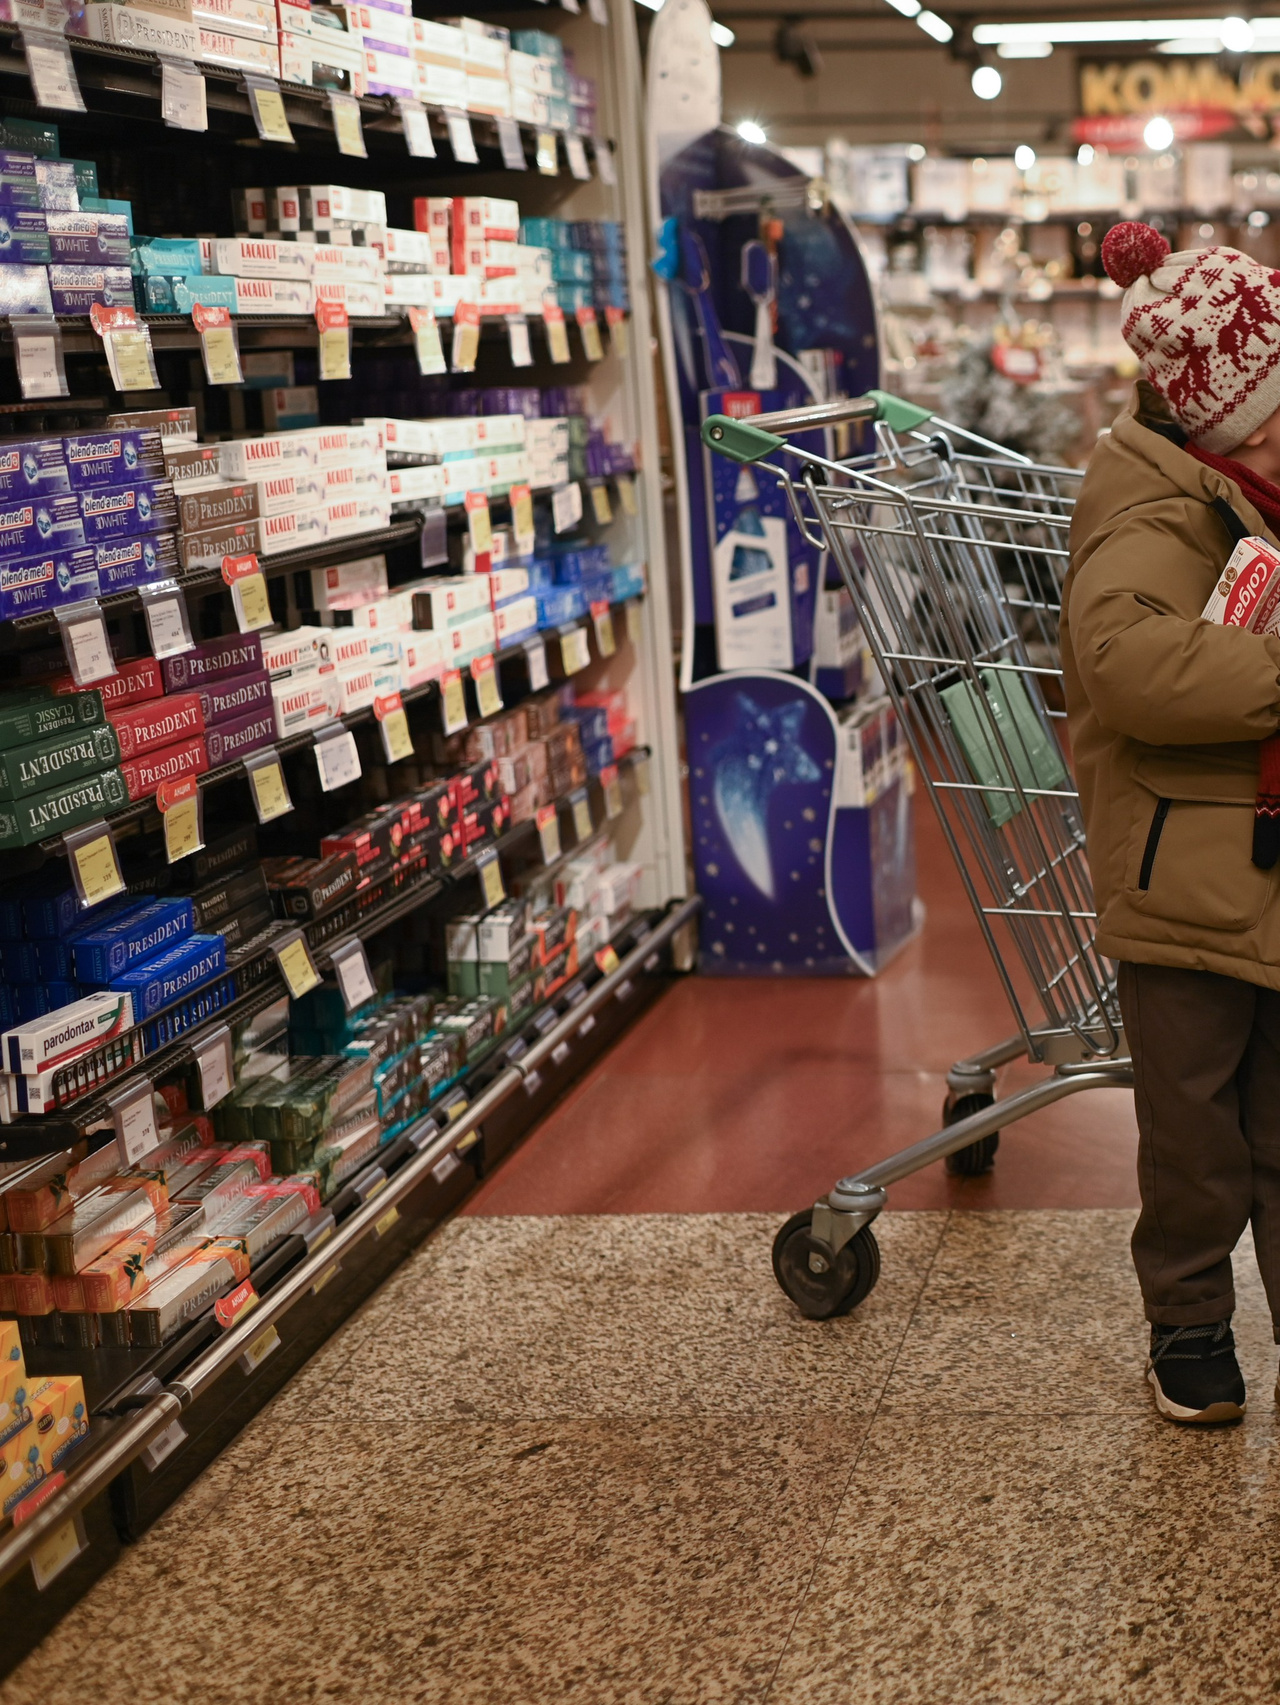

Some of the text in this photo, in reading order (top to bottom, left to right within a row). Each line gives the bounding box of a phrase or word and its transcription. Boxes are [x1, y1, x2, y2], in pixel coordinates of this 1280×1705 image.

[101, 8, 112, 42] SMOKERS
[135, 22, 196, 52] PRESIDENT
[240, 242, 277, 259] LACALUT
[237, 281, 273, 298] LACALUT
[246, 441, 281, 460] LACALUT
[265, 477, 295, 498] LACALUT
[201, 494, 254, 520] PRESIDENT
[265, 514, 296, 536] LACALUT
[203, 532, 256, 557] PRESIDENT
[190, 645, 257, 676] PRESIDENT
[213, 680, 268, 713] PRESIDENT
[282, 692, 311, 715] LACALUT
[36, 703, 74, 724] CLASSIC
[38, 715, 76, 733] PRESIDENT
[134, 707, 197, 744] PRESIDENT
[223, 717, 273, 752] PRESIDENT
[19, 740, 96, 782] PRESIDENT
[139, 748, 201, 786] PRESIDENT
[173, 783, 191, 798] АКЦИЯ
[29, 784, 104, 828] PRESIDENT
[201, 891, 227, 910] PRESIDENT
[204, 904, 230, 922] RENOME
[128, 913, 188, 959] PRESIDENT
[216, 919, 239, 936] PRESIDENT
[163, 951, 221, 998] PRESIDENT
[43, 1018, 95, 1057] parodontax
[232, 1287, 249, 1308] АКЦИЯ
